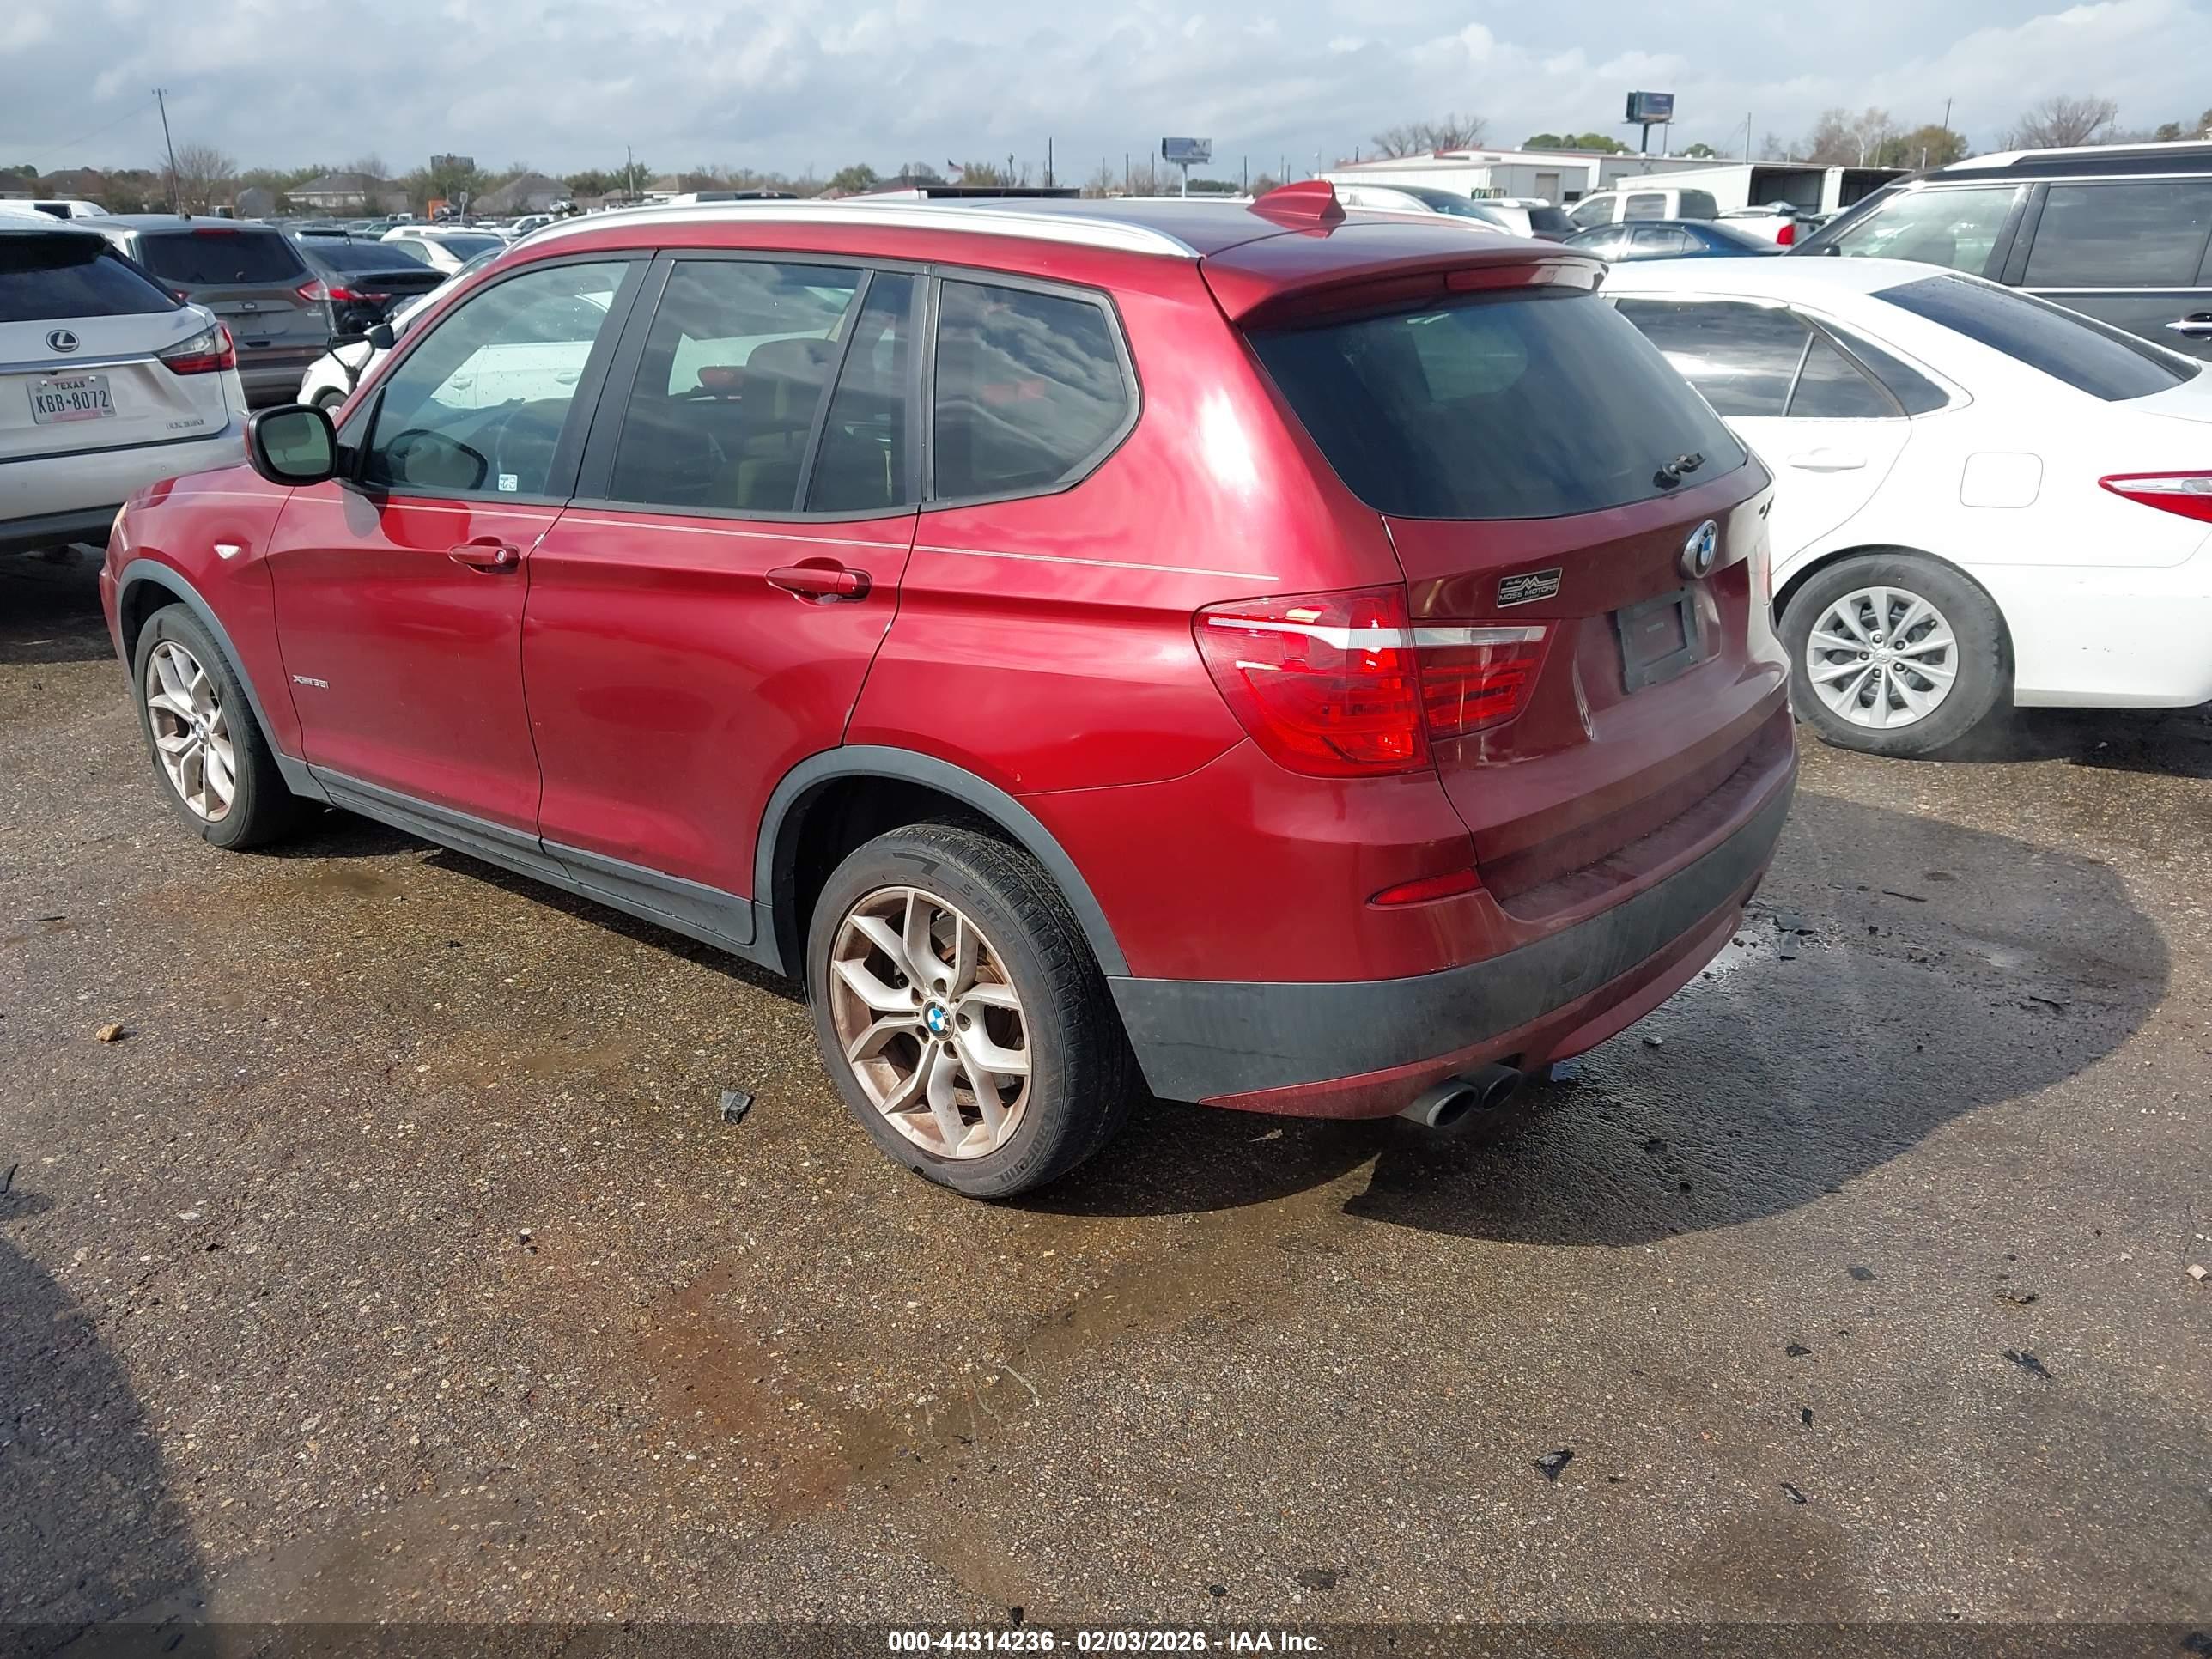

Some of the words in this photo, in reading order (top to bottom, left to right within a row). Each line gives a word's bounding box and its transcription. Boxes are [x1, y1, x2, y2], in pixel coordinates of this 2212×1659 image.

[54, 380, 85, 391] TEXAS
[1498, 591, 1523, 601] MOSS
[1524, 585, 1558, 596] MOTORS
